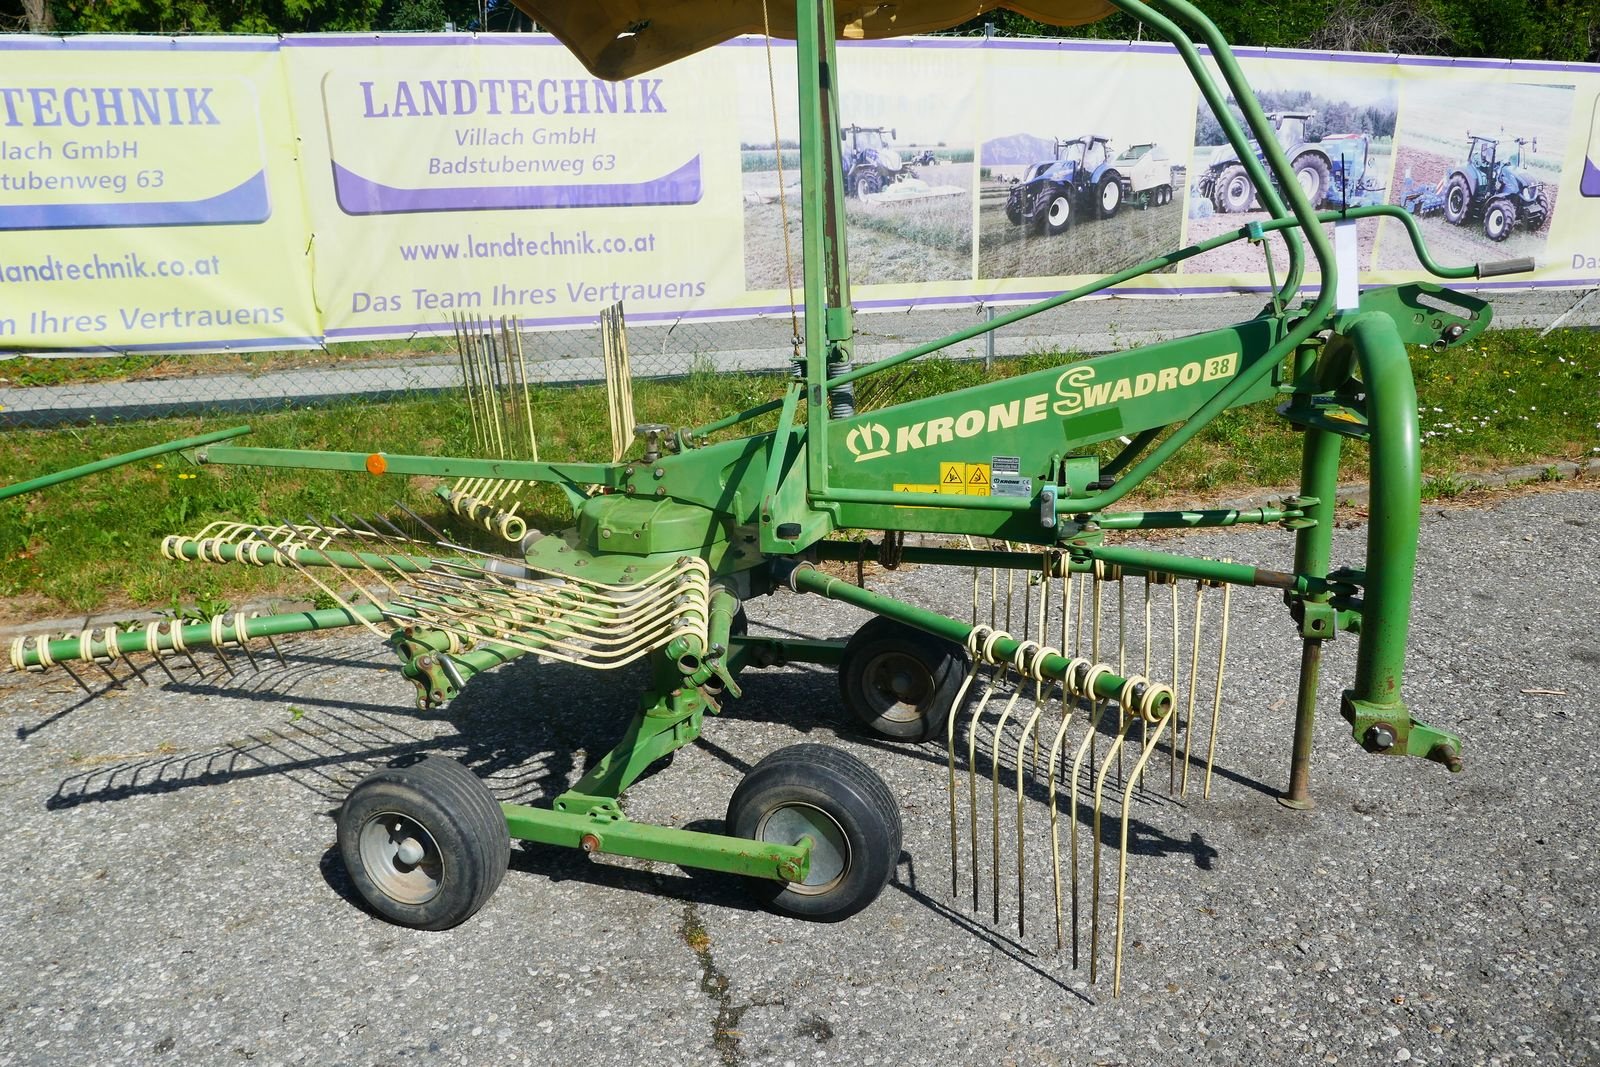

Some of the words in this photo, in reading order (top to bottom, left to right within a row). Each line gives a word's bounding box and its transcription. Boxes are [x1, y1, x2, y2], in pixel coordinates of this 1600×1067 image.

[0, 87, 220, 127] TECHNIK
[361, 78, 667, 118] LANDTECHNIK
[1, 140, 52, 160] lach
[61, 139, 138, 159] GmbH
[454, 127, 523, 146] Villach
[532, 126, 596, 145] GmbH
[428, 155, 585, 176] Badstubenweg
[592, 154, 616, 171] 63
[0, 170, 127, 194] tubenweg
[136, 169, 164, 188] 63
[400, 230, 656, 261] www.landtechnik.co.at
[1571, 253, 1600, 270] Da
[351, 292, 402, 314] Das
[412, 288, 482, 311] Team
[492, 283, 557, 307] Ihres
[566, 280, 706, 306] Vertrauens
[30, 309, 107, 334] Ihres
[119, 306, 285, 330] Vertrauens
[895, 392, 1050, 454] KRONE
[1209, 358, 1231, 377] 38
